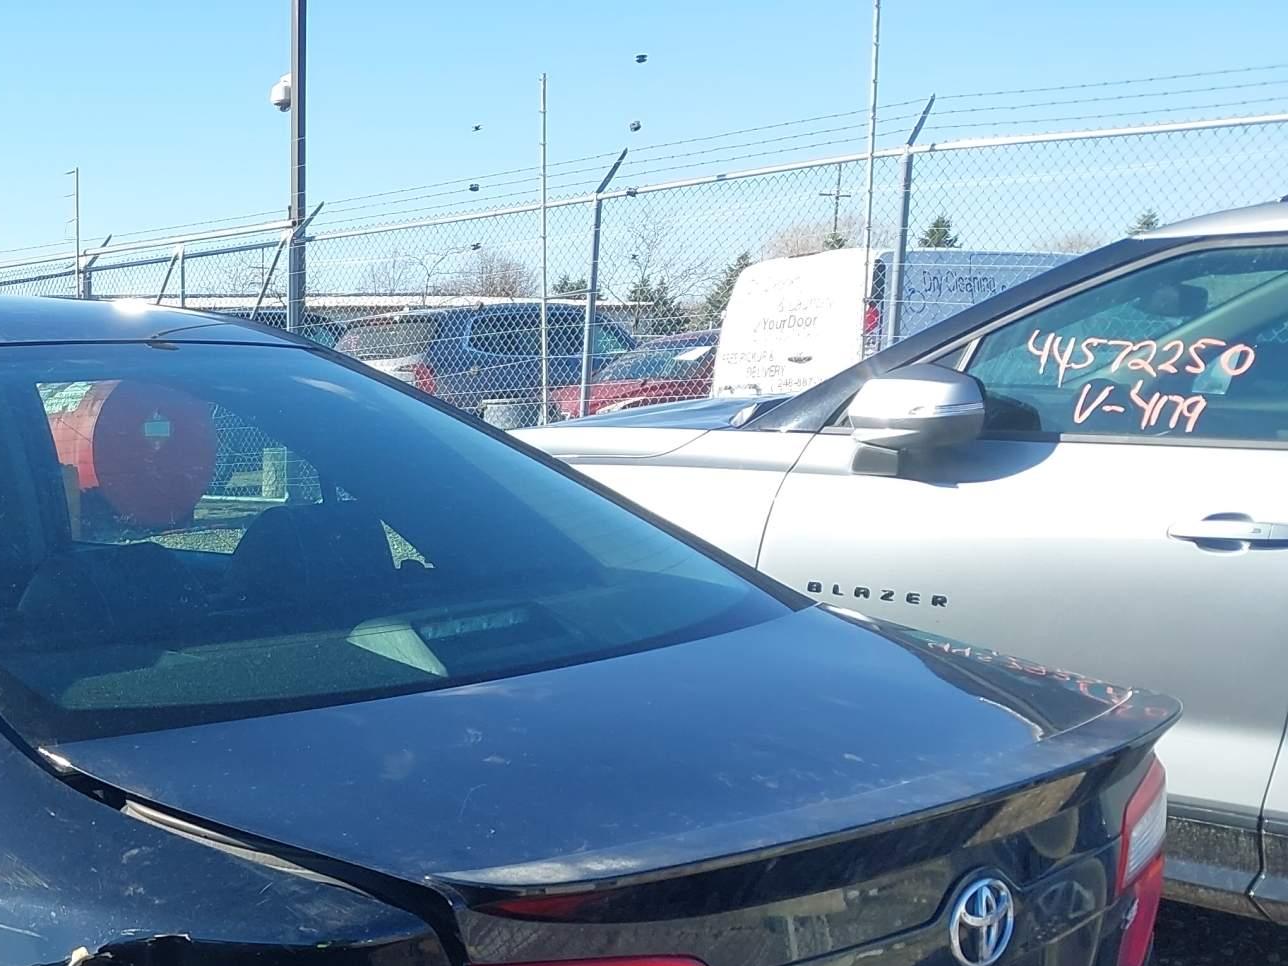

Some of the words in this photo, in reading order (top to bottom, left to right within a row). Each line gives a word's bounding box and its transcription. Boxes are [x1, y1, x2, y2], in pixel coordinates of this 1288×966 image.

[923, 270, 943, 297] Dry
[1028, 329, 1256, 388] 44572250
[807, 581, 948, 608] BLAZER
